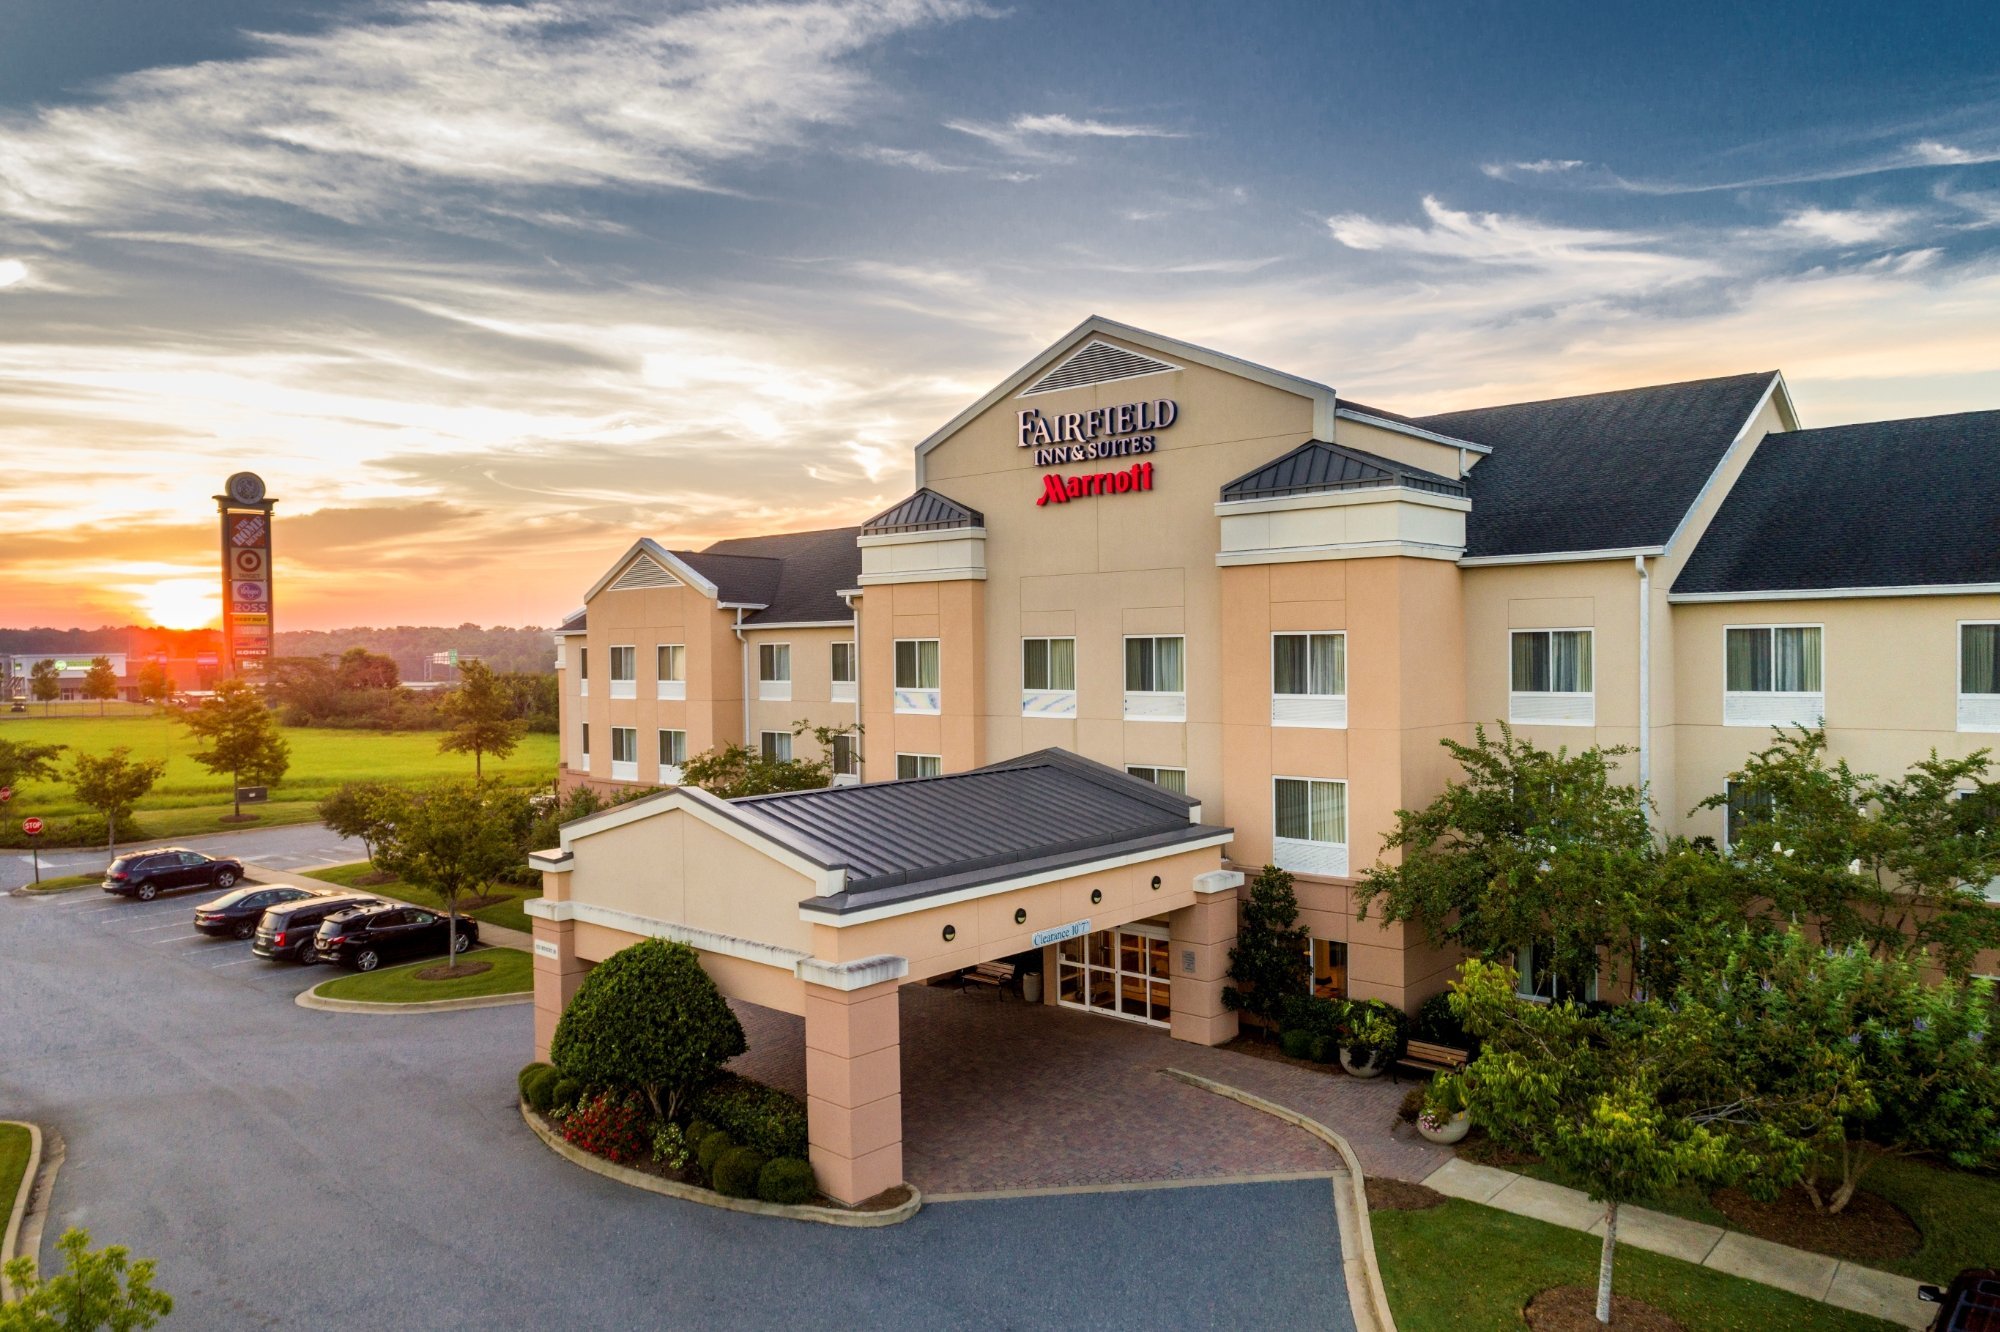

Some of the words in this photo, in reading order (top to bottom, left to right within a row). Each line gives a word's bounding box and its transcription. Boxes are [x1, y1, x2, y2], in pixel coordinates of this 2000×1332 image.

[1016, 399, 1178, 448] FAIRFIELD
[1087, 435, 1156, 460] SUITES
[1036, 461, 1154, 506] Marriott
[232, 516, 264, 546] HOME
[234, 603, 266, 612] ROSS
[1034, 929, 1069, 945] Clearance
